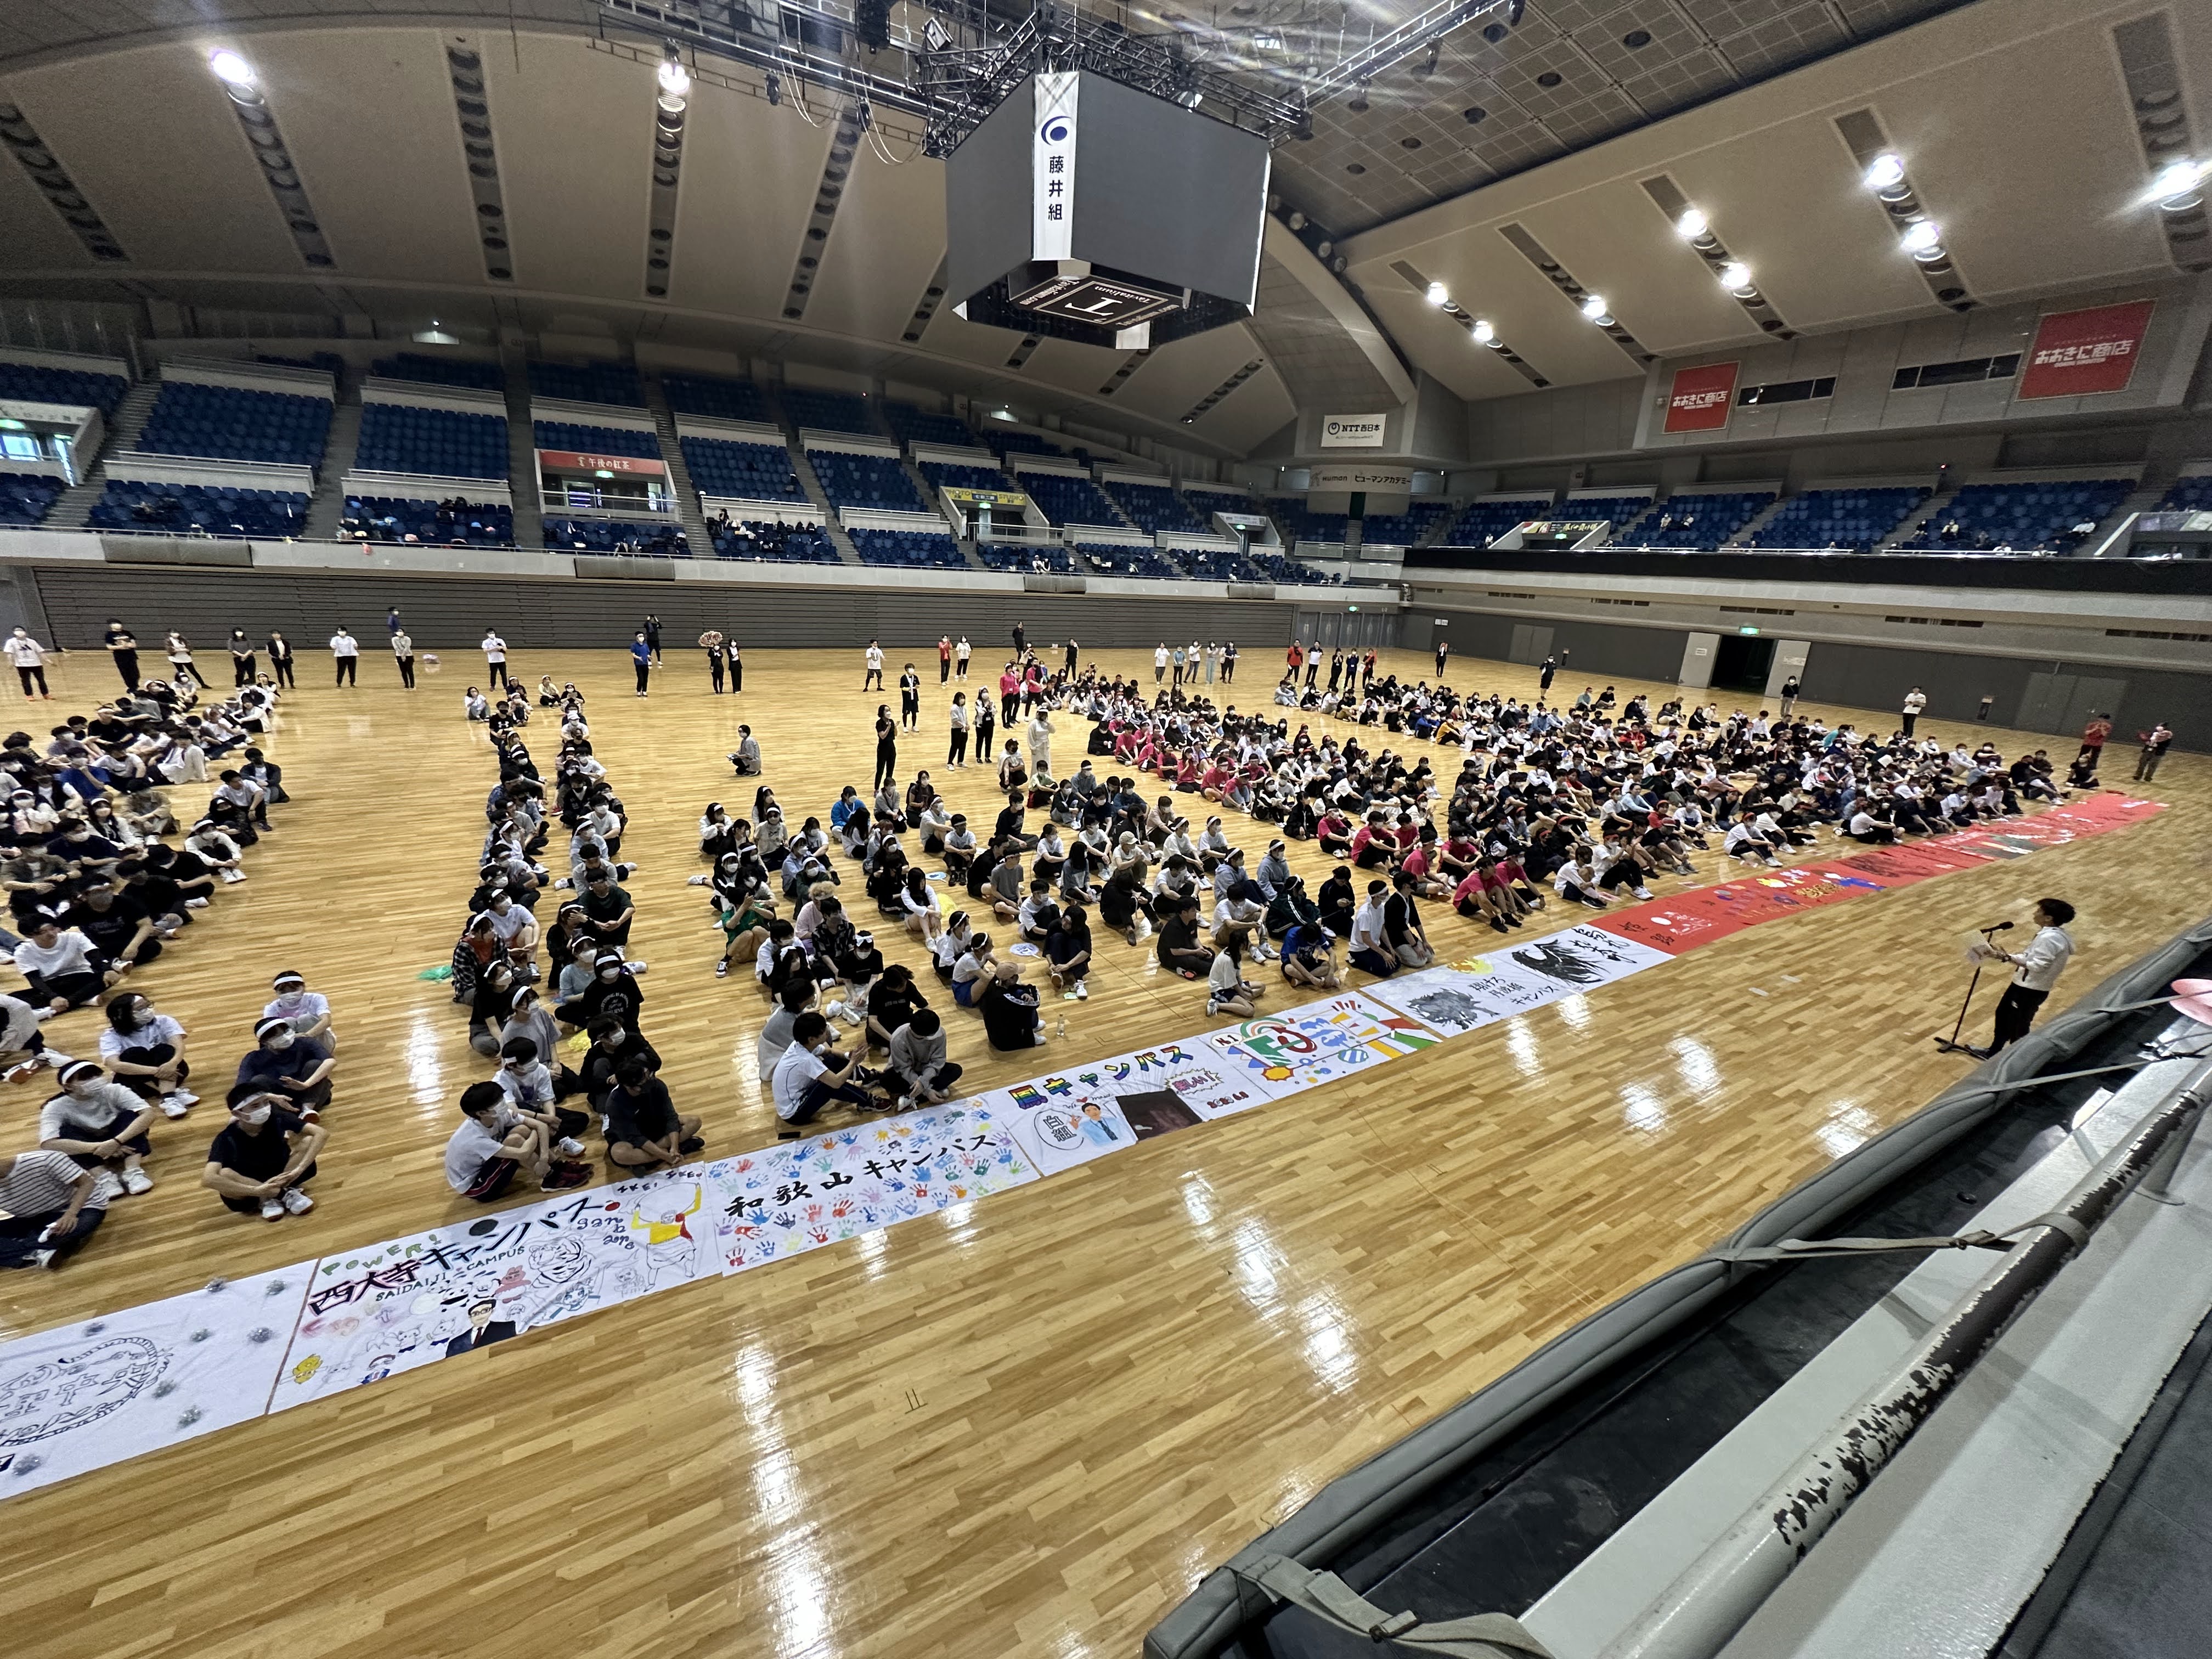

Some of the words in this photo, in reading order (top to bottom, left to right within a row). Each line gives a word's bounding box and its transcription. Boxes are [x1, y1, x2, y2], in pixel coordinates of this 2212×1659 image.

[1048, 155, 1064, 221] 藤井組
[1094, 285, 1152, 304] Tavitalium
[2034, 340, 2135, 365] おおきに商店
[1672, 391, 1729, 407] おおきに商店
[588, 458, 630, 470] 午後の紅茶
[1355, 475, 1412, 484] ヒューマンアカデミー
[1043, 1115, 1077, 1142] 白組
[724, 1134, 997, 1218] 和歌山キャンパス
[307, 1196, 604, 1316] 西大寺キャンパス
[375, 1272, 447, 1302] SAIDAIJI
[466, 1245, 525, 1271] CAMPUS
